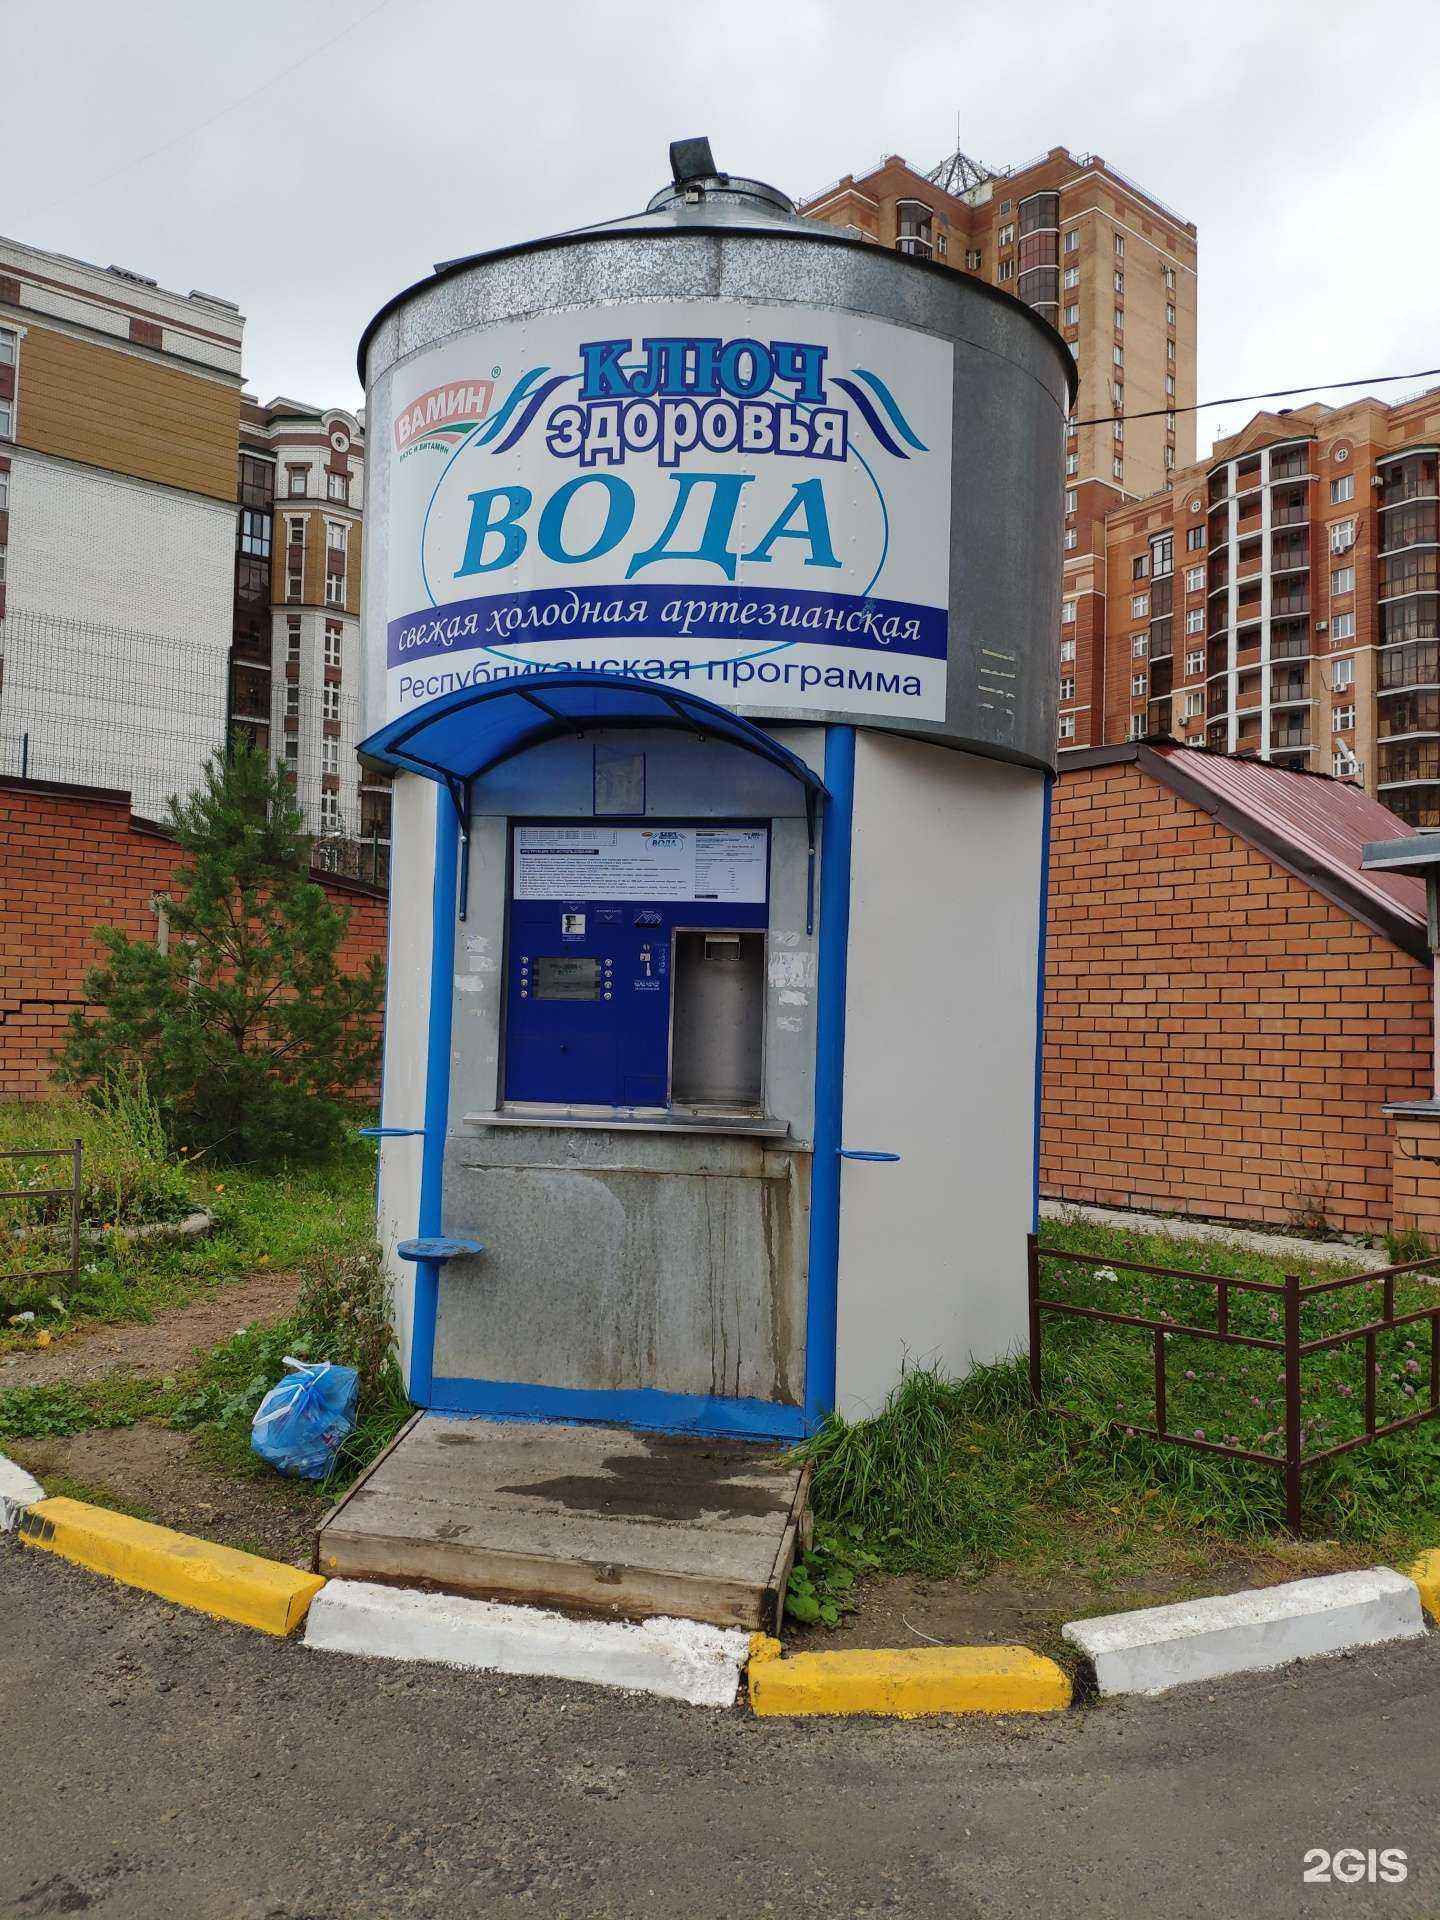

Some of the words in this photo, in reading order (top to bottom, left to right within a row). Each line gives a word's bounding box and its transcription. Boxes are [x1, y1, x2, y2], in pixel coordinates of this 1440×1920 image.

[578, 338, 828, 405] КЛЮЧ
[398, 386, 487, 445] ВАМИН
[452, 472, 843, 581] ВОДА
[398, 613, 479, 651] свежая
[486, 590, 649, 637] холодная
[660, 599, 921, 645] артезианская
[707, 659, 921, 696] программа
